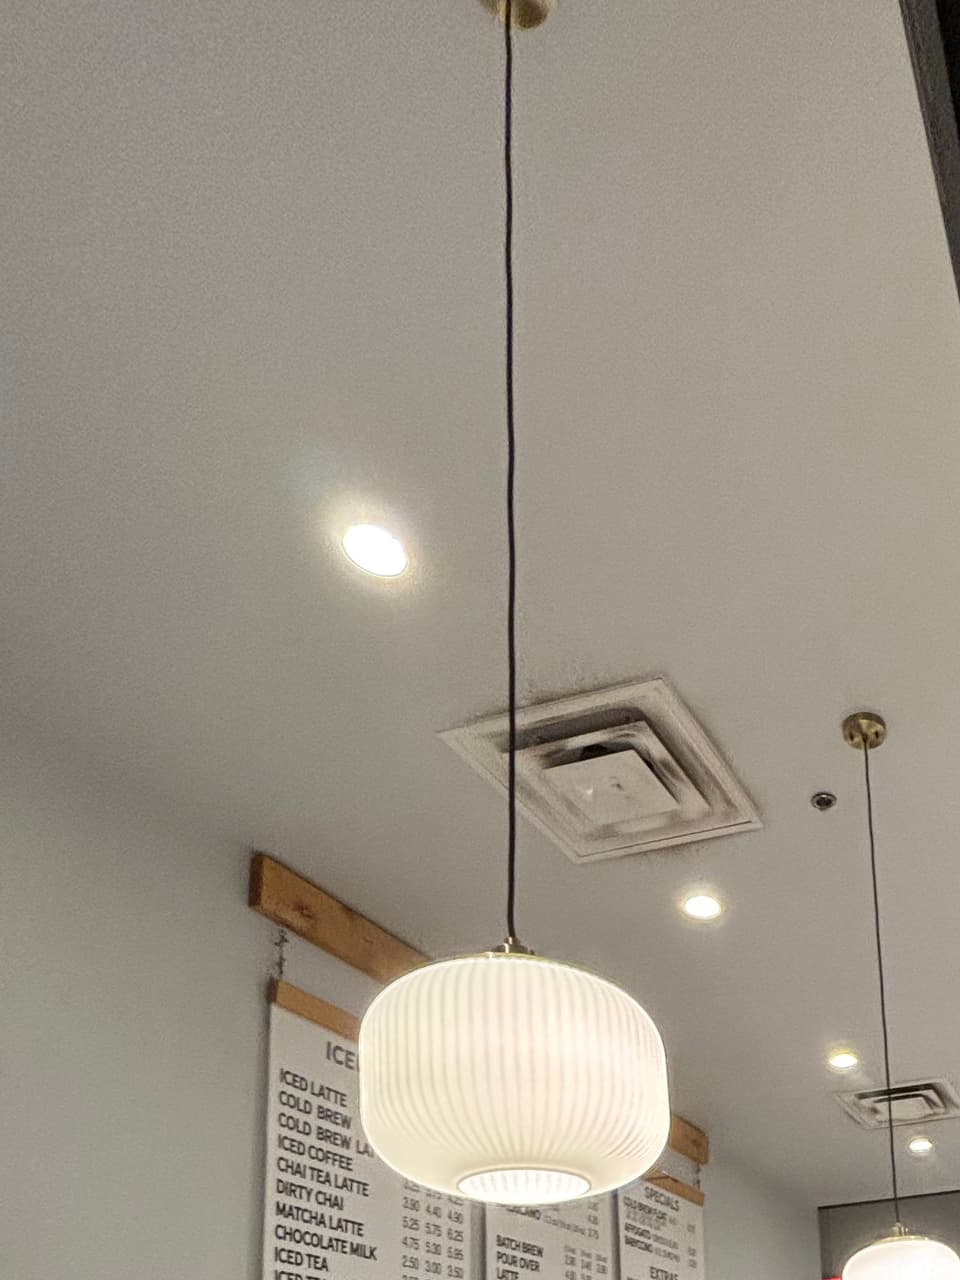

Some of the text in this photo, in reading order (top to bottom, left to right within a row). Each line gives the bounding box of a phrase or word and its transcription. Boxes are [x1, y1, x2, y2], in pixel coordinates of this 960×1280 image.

[326, 1041, 360, 1071] ICE
[280, 1068, 347, 1107] ICED LATTE
[279, 1091, 352, 1129] COLD BREW
[278, 1112, 312, 1136] COLD
[316, 1126, 351, 1149] BREW
[278, 1134, 353, 1171] ICED COFFEE
[277, 1156, 369, 1197] CHAI TEA LATTE
[277, 1179, 344, 1210] DIRTY CHAI
[276, 1201, 364, 1237] MATCHA LATTE
[275, 1224, 377, 1260] CHOCOLATE MILK
[275, 1247, 328, 1272] ICED TEA
[497, 1234, 544, 1258] BATCH BREW
[497, 1251, 540, 1272] POUR OVER
